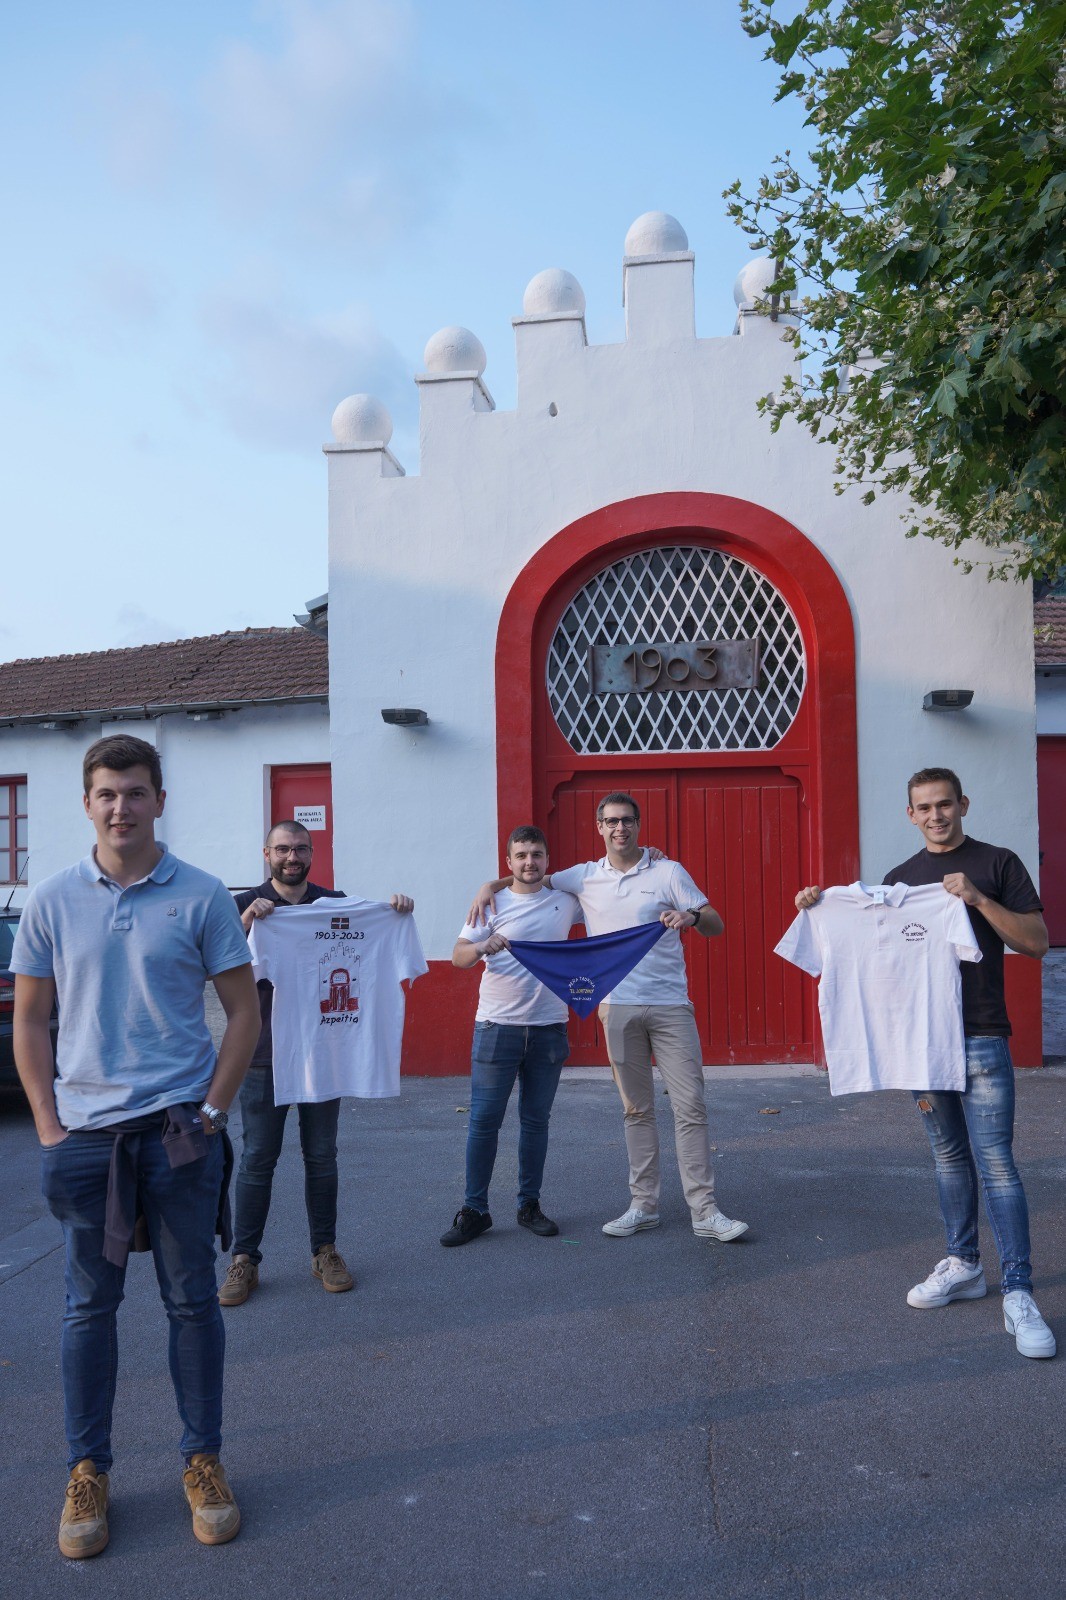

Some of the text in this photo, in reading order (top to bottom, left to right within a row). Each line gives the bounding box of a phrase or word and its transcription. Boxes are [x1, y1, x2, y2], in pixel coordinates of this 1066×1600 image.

[624, 648, 718, 690] 1903
[314, 931, 365, 940] 1903-2023
[320, 1013, 359, 1026] Azpeitia
